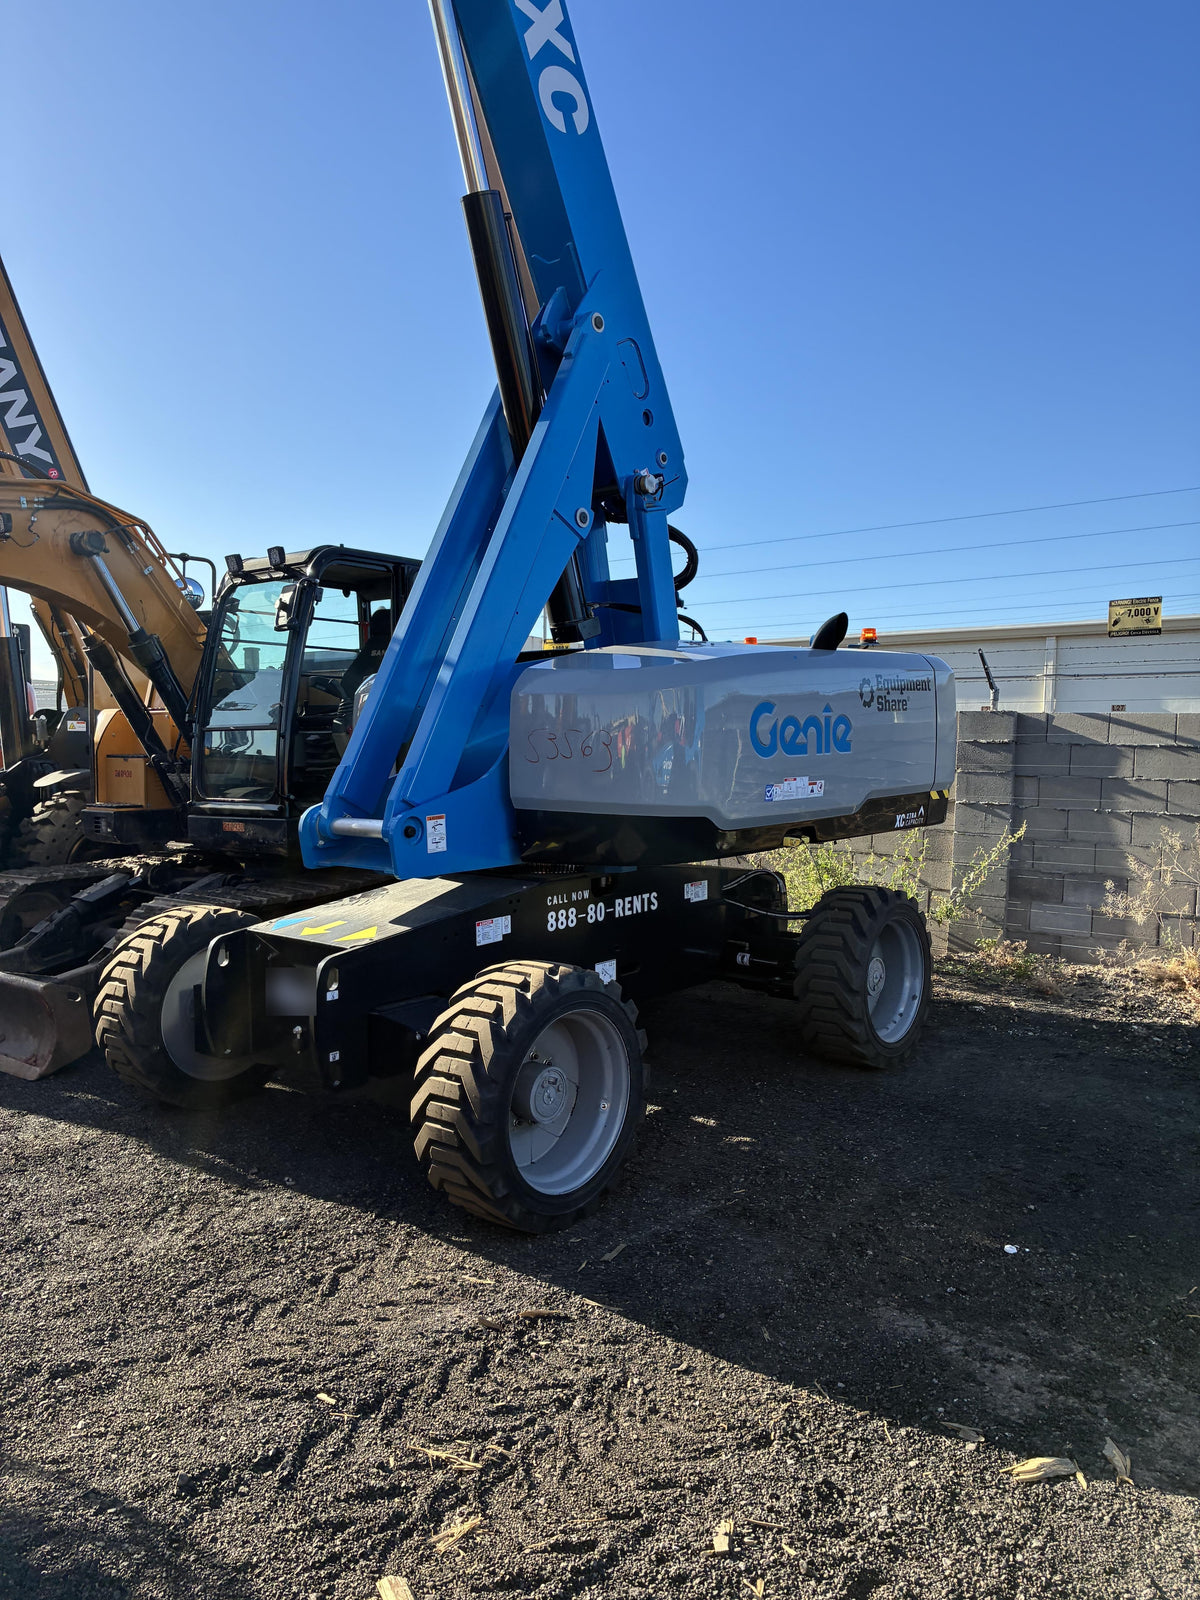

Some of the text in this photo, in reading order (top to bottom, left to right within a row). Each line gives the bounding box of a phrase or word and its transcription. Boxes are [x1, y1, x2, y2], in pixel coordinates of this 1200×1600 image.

[514, 0, 589, 135] XC
[1127, 606, 1160, 618] 7,000 V
[875, 674, 931, 695] Equipment
[750, 700, 853, 759] Genie
[894, 813, 905, 828] XC
[547, 889, 590, 906] CALL NOW
[547, 891, 658, 932] 888-80-RENTS
